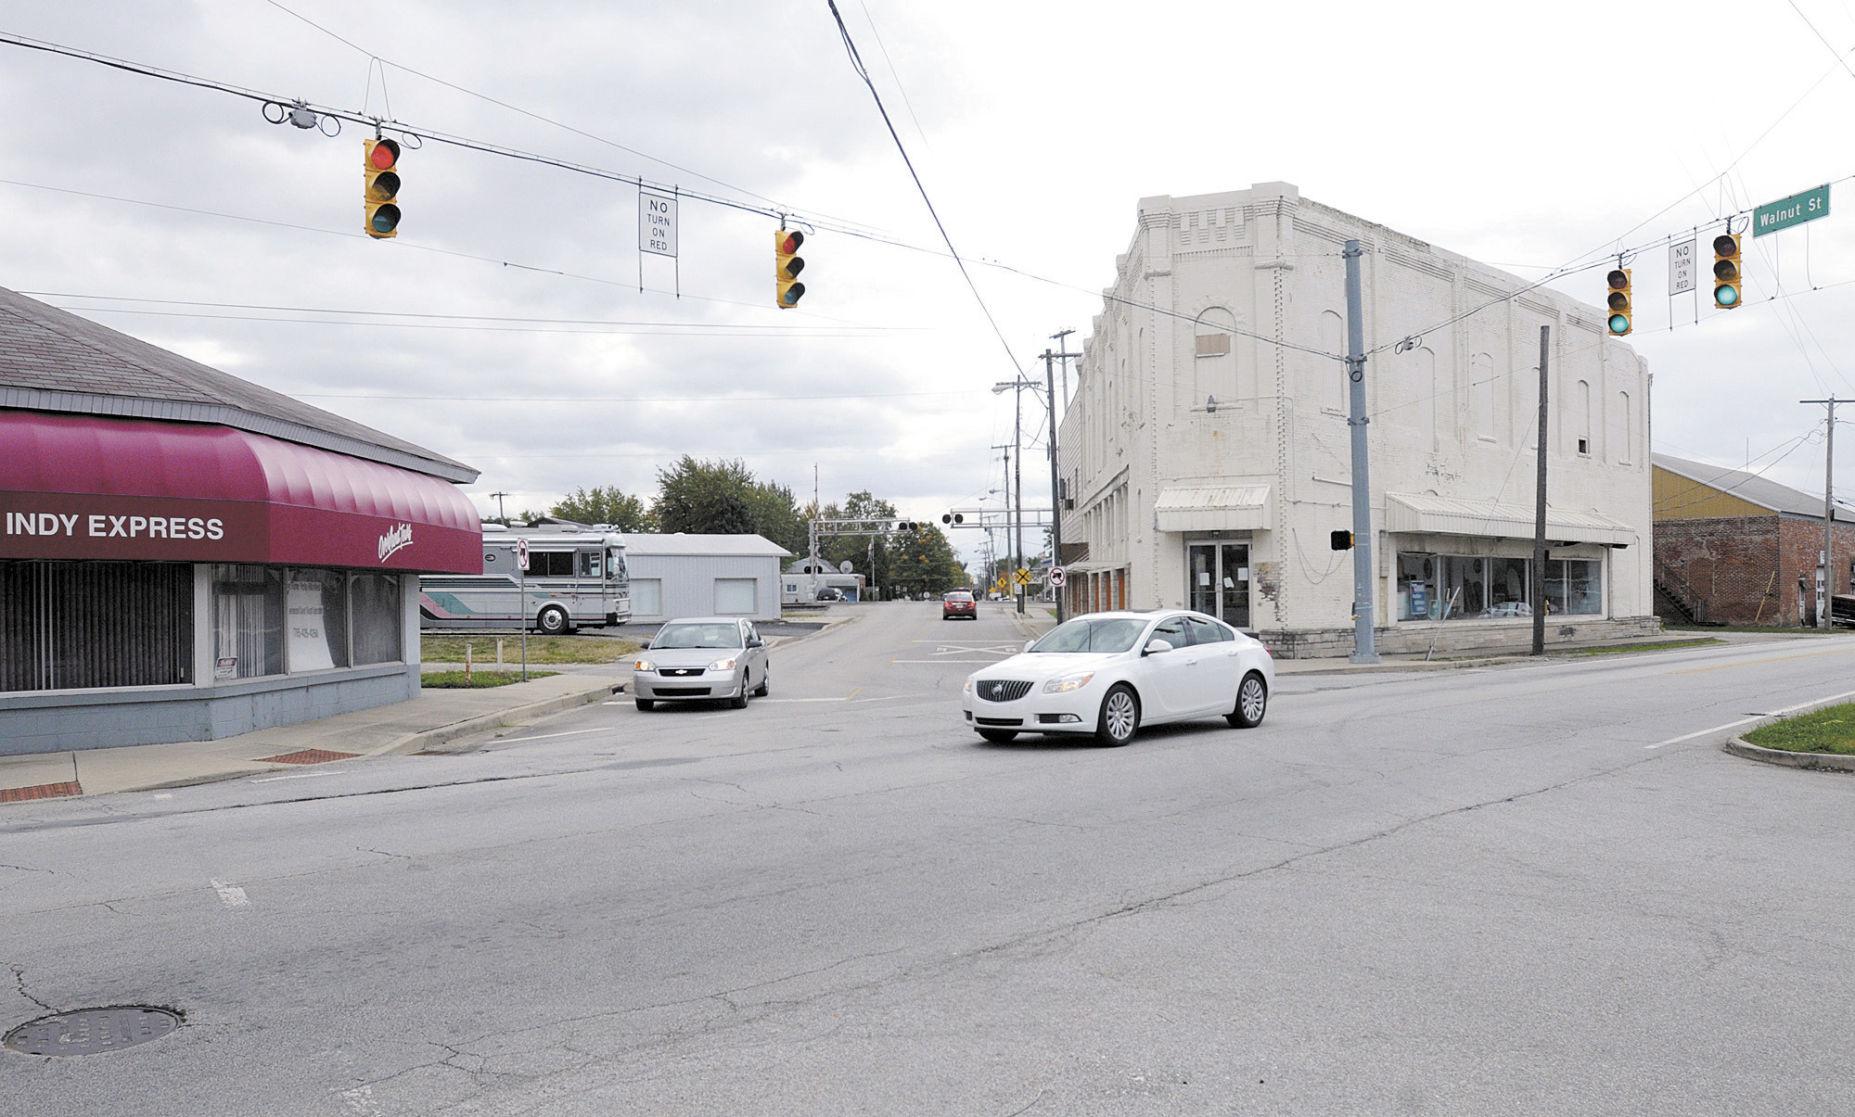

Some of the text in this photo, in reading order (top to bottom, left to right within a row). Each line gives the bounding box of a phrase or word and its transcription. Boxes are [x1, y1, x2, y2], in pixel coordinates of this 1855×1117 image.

[650, 200, 668, 213] NO
[1760, 196, 1822, 227] Walnut St
[647, 213, 670, 226] TURN
[652, 227, 665, 238] ON
[650, 239, 668, 251] RED
[1676, 245, 1689, 258] NO
[1674, 258, 1691, 269] TURN
[1677, 270, 1687, 279] ON
[1676, 279, 1689, 289] RED
[6, 512, 224, 540] INDY EXPRESS
